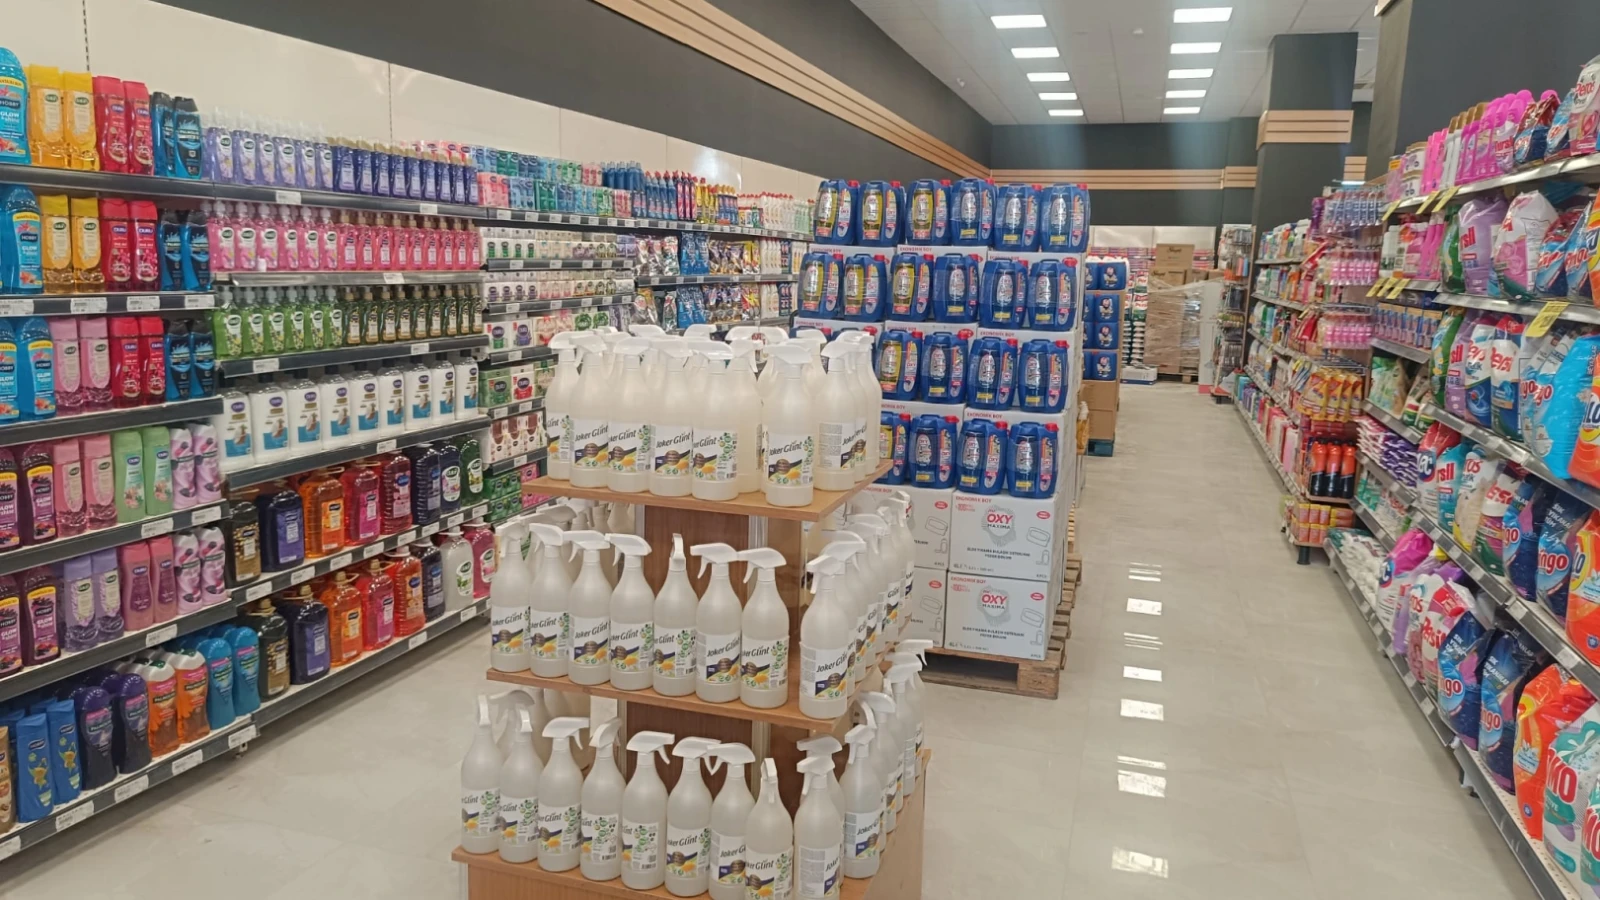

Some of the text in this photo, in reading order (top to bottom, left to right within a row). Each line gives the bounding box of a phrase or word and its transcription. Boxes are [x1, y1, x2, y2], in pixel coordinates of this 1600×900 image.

[987, 513, 1012, 524] OXY
[982, 594, 1007, 604] OXY
[816, 662, 835, 672] Joker
[680, 834, 698, 846] Glint
[720, 849, 737, 858] Joker
[756, 858, 774, 870] Glint
